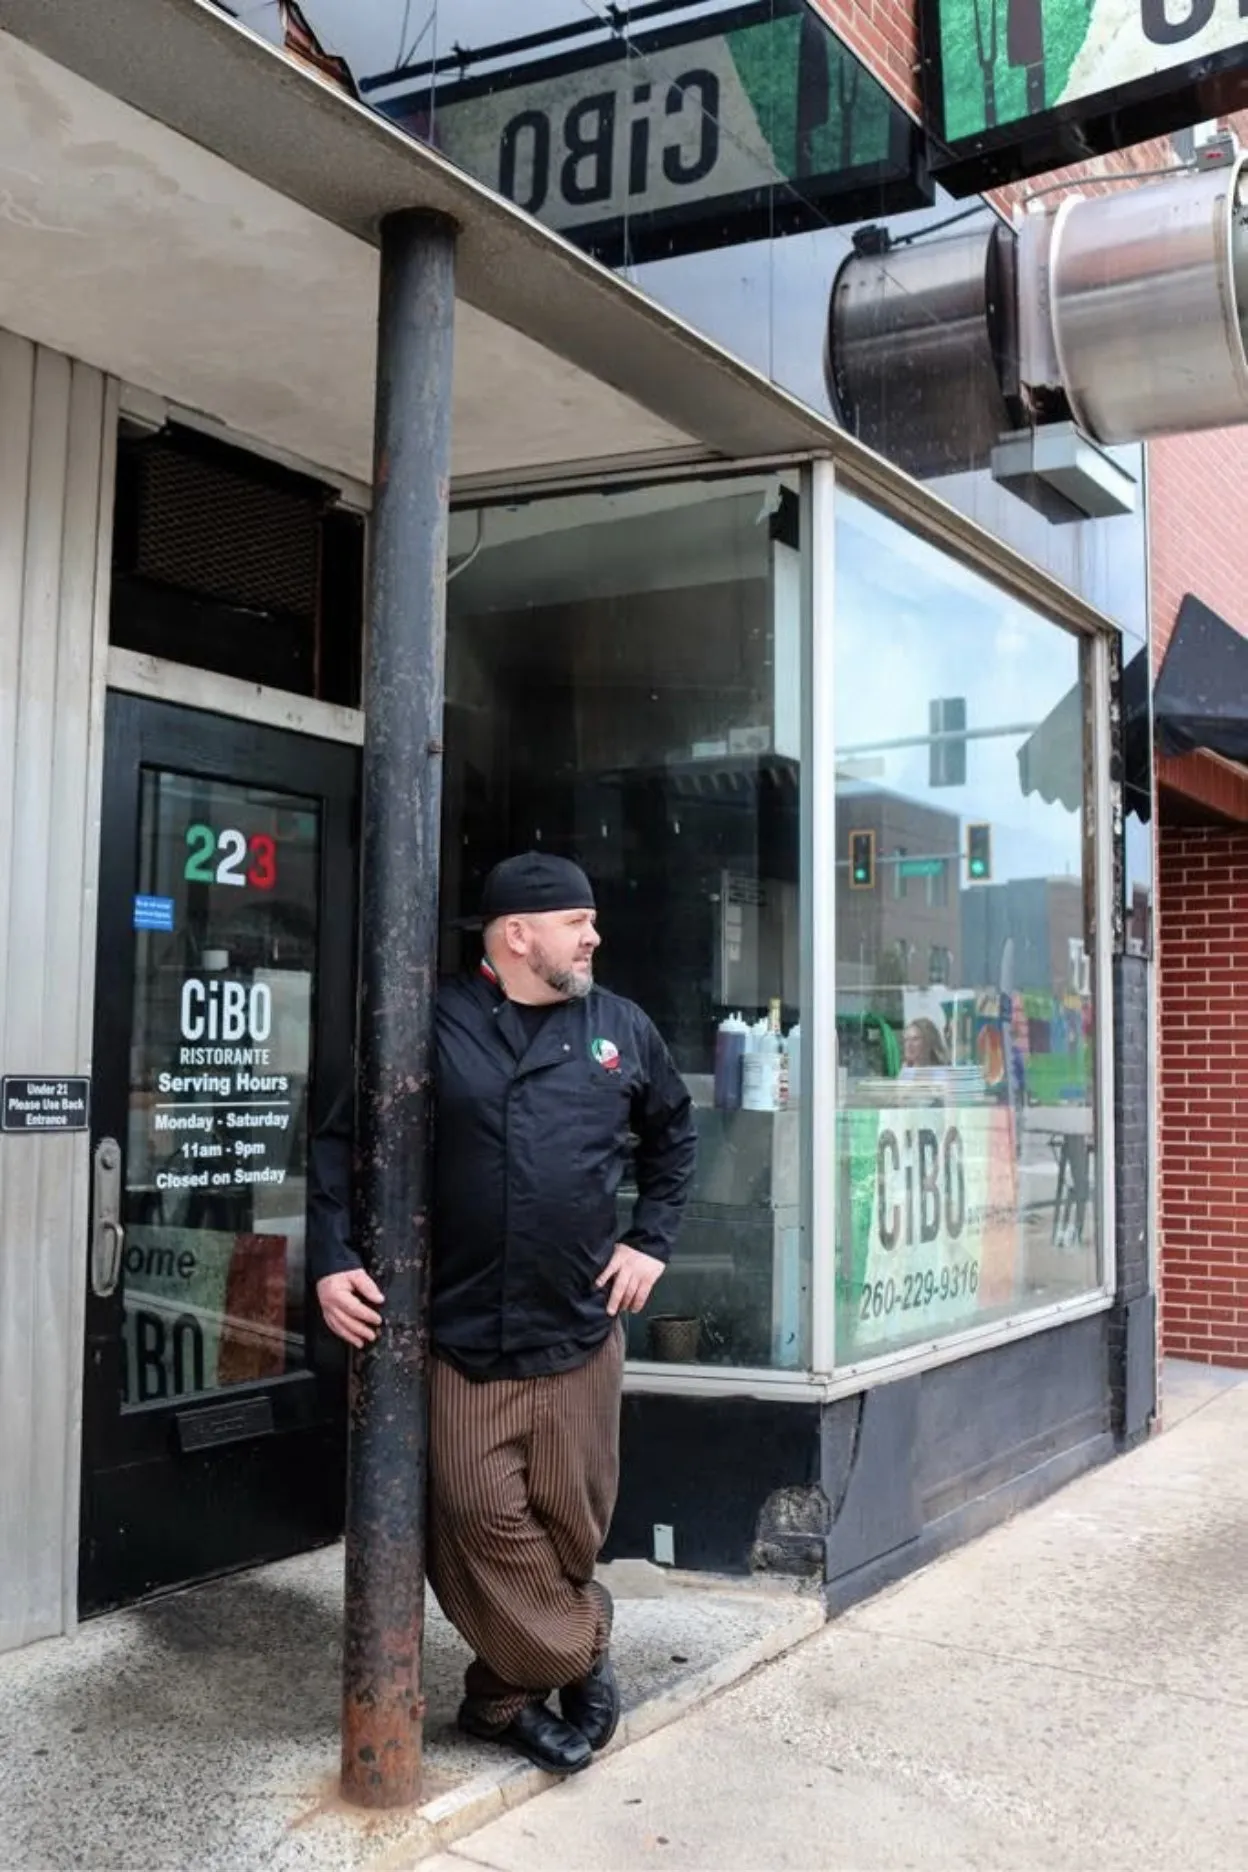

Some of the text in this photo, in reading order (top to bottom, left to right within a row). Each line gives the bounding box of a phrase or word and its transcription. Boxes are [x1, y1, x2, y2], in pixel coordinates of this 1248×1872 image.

[184, 824, 277, 889] 223
[180, 978, 272, 1041] CiBO
[180, 1048, 270, 1065] RISTORANTE
[27, 1082, 68, 1096] Under 21
[158, 1072, 288, 1096] Serving Hours
[8, 1097, 84, 1111] Please Use Back
[26, 1112, 68, 1126] Entrance
[154, 1112, 214, 1132] Monday
[226, 1111, 289, 1130] Saturday
[181, 1142, 222, 1158] 11am
[234, 1140, 266, 1158] 9pm
[156, 1166, 286, 1189] Closed on Sunday
[877, 1126, 965, 1251] CiBO
[859, 1260, 979, 1321] 260-229-9316
